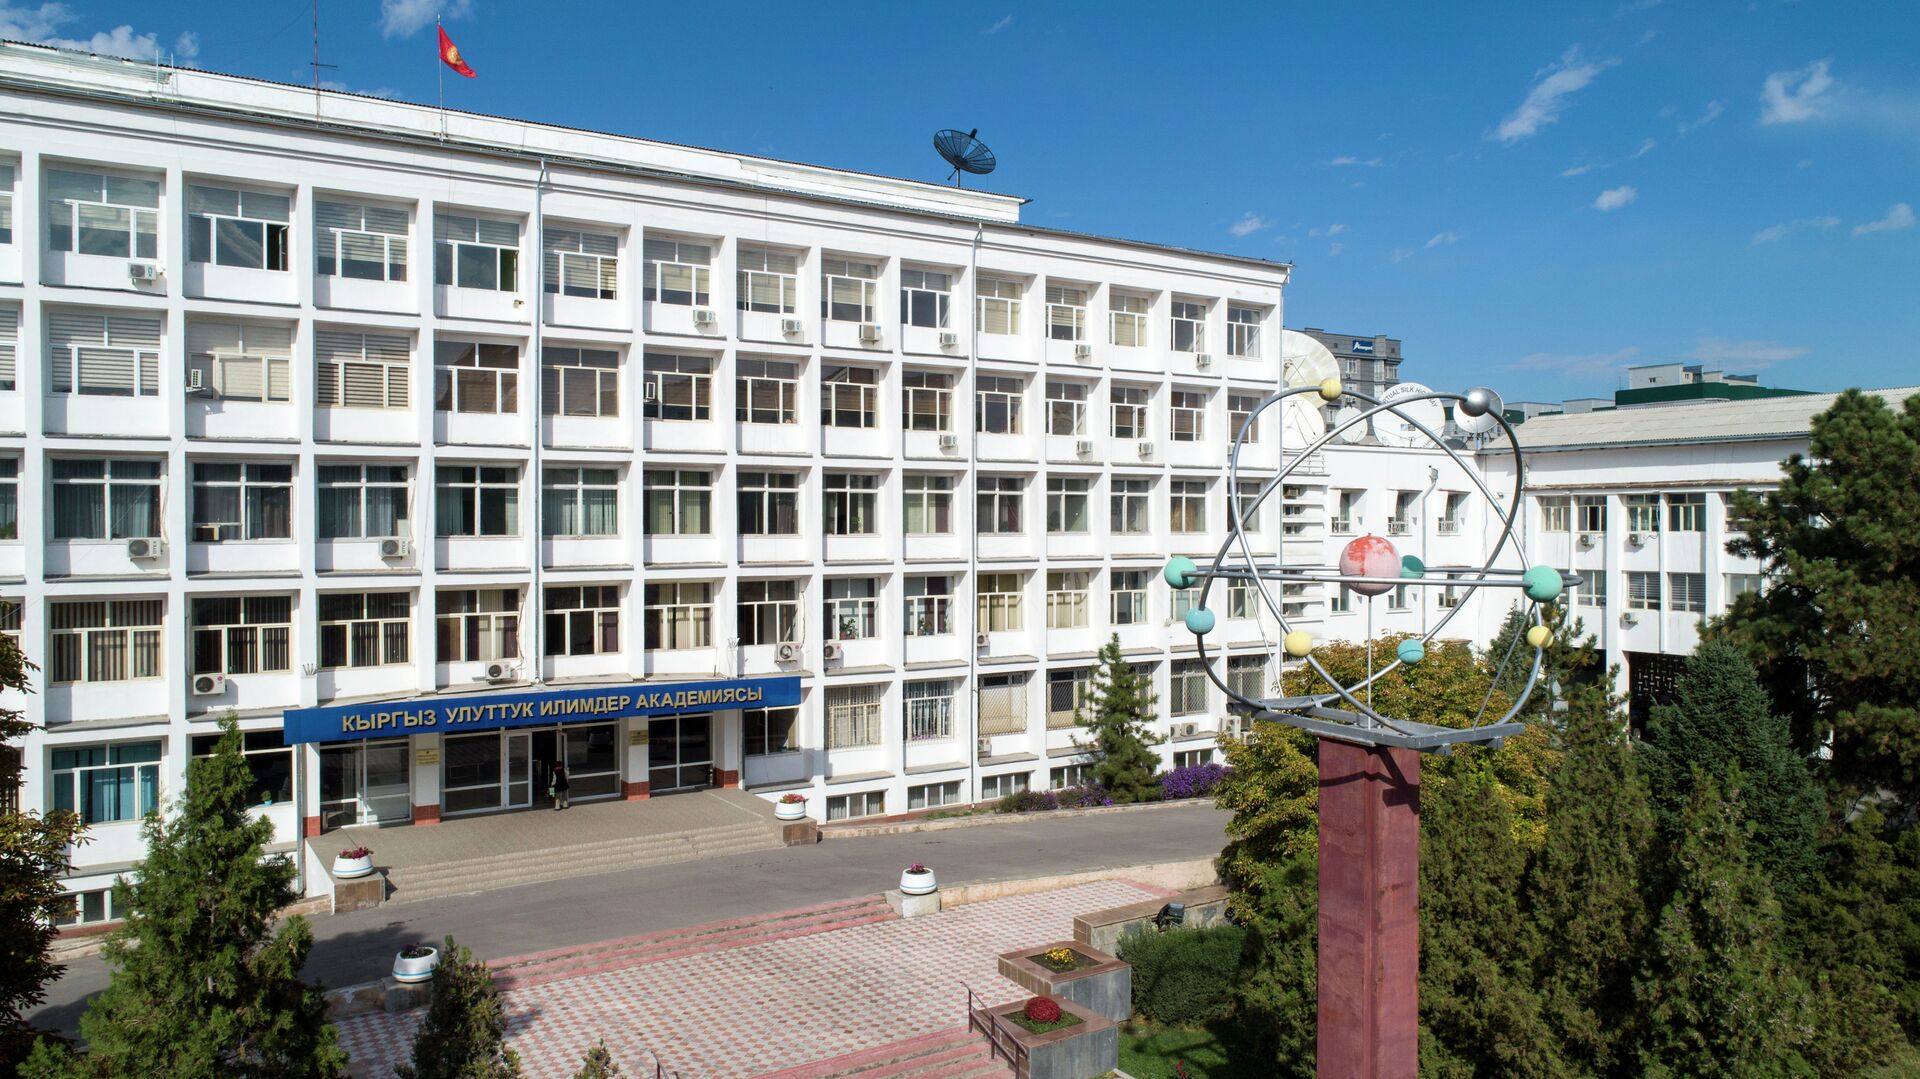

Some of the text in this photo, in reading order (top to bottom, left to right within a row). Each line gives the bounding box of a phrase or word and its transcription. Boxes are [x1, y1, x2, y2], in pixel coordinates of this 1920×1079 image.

[342, 686, 763, 733] КЫРГЫЗ УЛУТТУК ИЛИМДЕР АКАДЕМИЯСЫ
